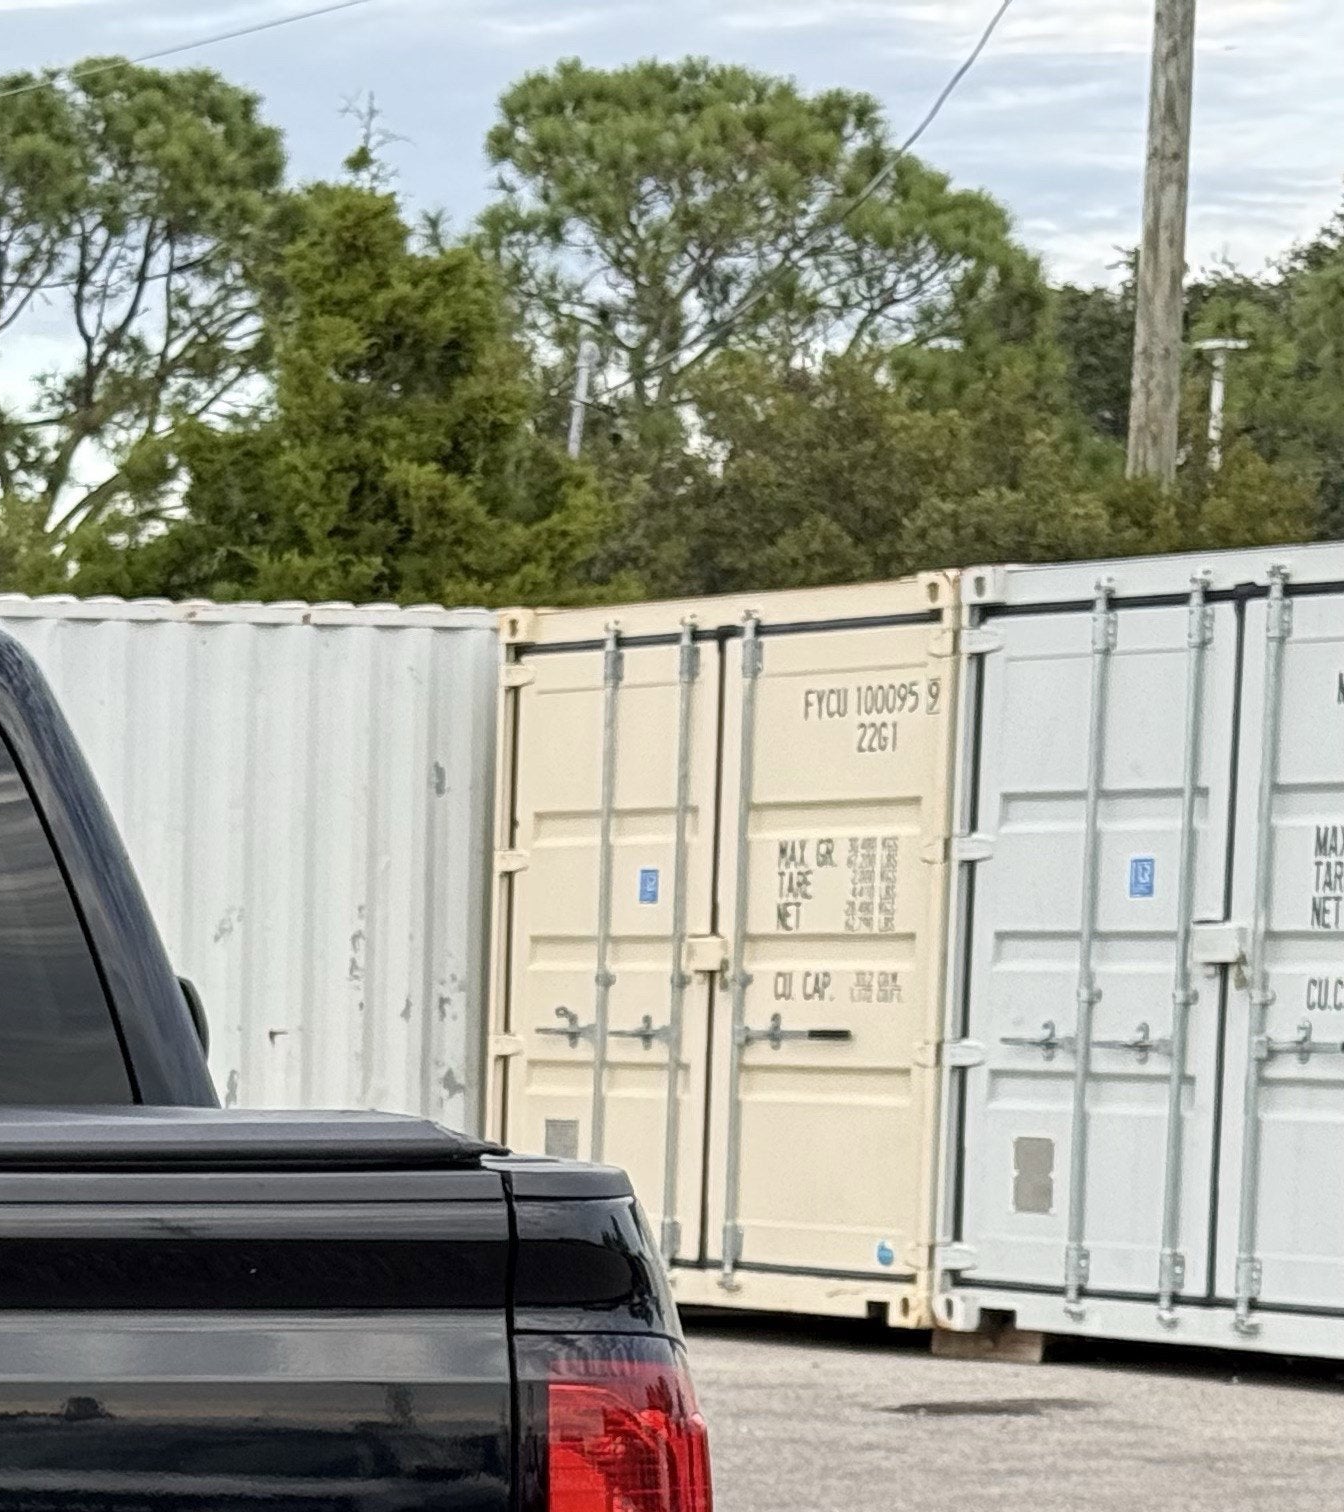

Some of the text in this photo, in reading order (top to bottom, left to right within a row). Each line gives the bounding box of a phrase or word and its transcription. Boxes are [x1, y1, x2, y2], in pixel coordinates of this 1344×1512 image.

[804, 679, 941, 720] FYCU 100095 9
[857, 721, 897, 752] 22G1
[778, 869, 813, 900] TARE
[1315, 861, 1344, 893] TAR
[777, 901, 802, 931] NET
[1311, 896, 1343, 929] NET
